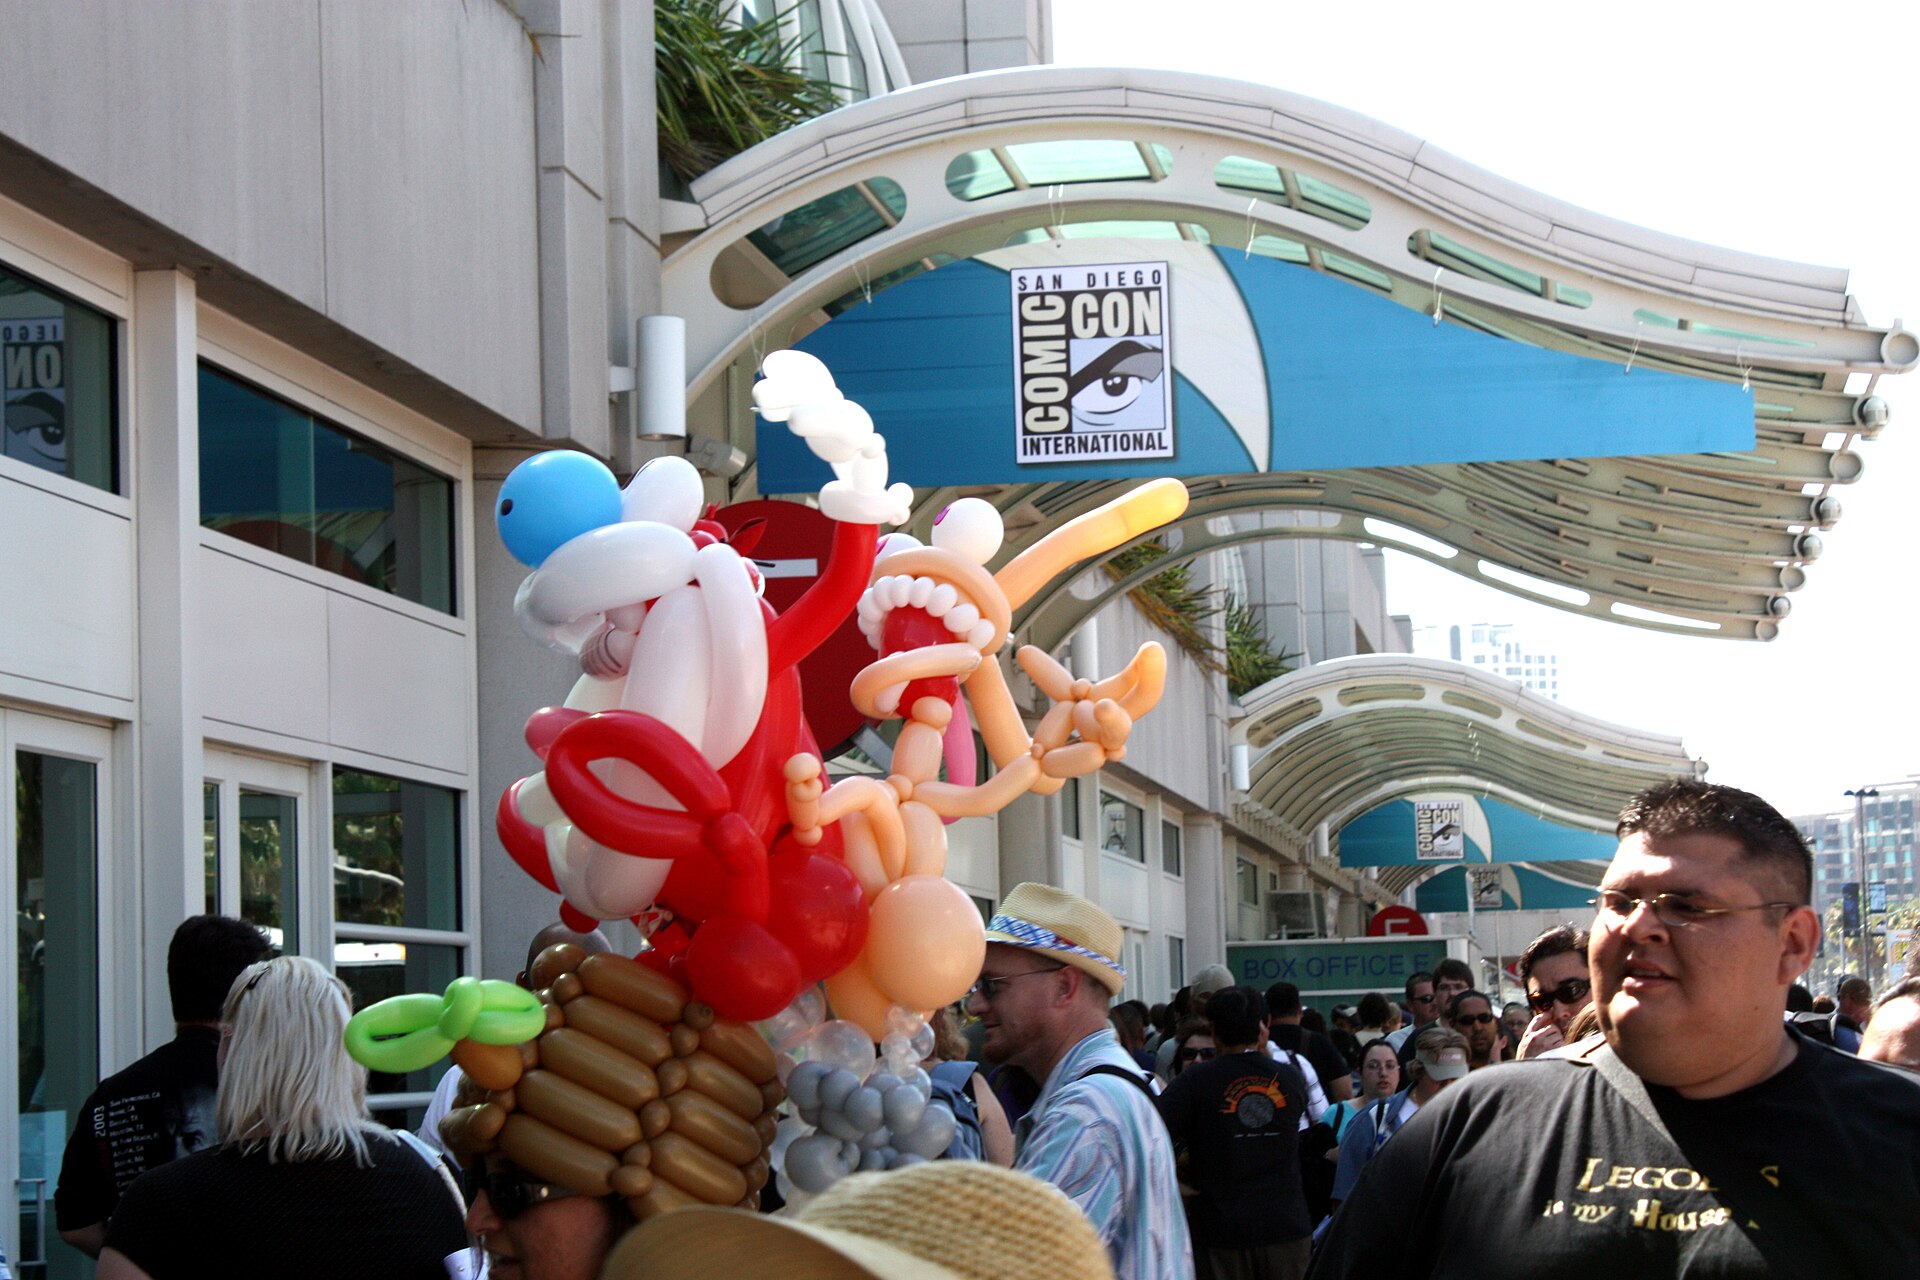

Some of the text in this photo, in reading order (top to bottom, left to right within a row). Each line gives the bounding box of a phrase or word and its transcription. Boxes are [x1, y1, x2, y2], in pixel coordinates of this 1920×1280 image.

[1018, 269, 1161, 291] SAN DIEGO
[1071, 290, 1161, 339] CON
[1021, 294, 1069, 433] COMIC
[1023, 431, 1168, 456] INTERNATIONAL
[1433, 809, 1460, 823] CON
[1418, 809, 1433, 851] COMIC
[1244, 957, 1298, 980] BOX
[1306, 955, 1405, 978] OFFICE
[94, 1105, 106, 1138] 2003
[1571, 1202, 1616, 1223] my
